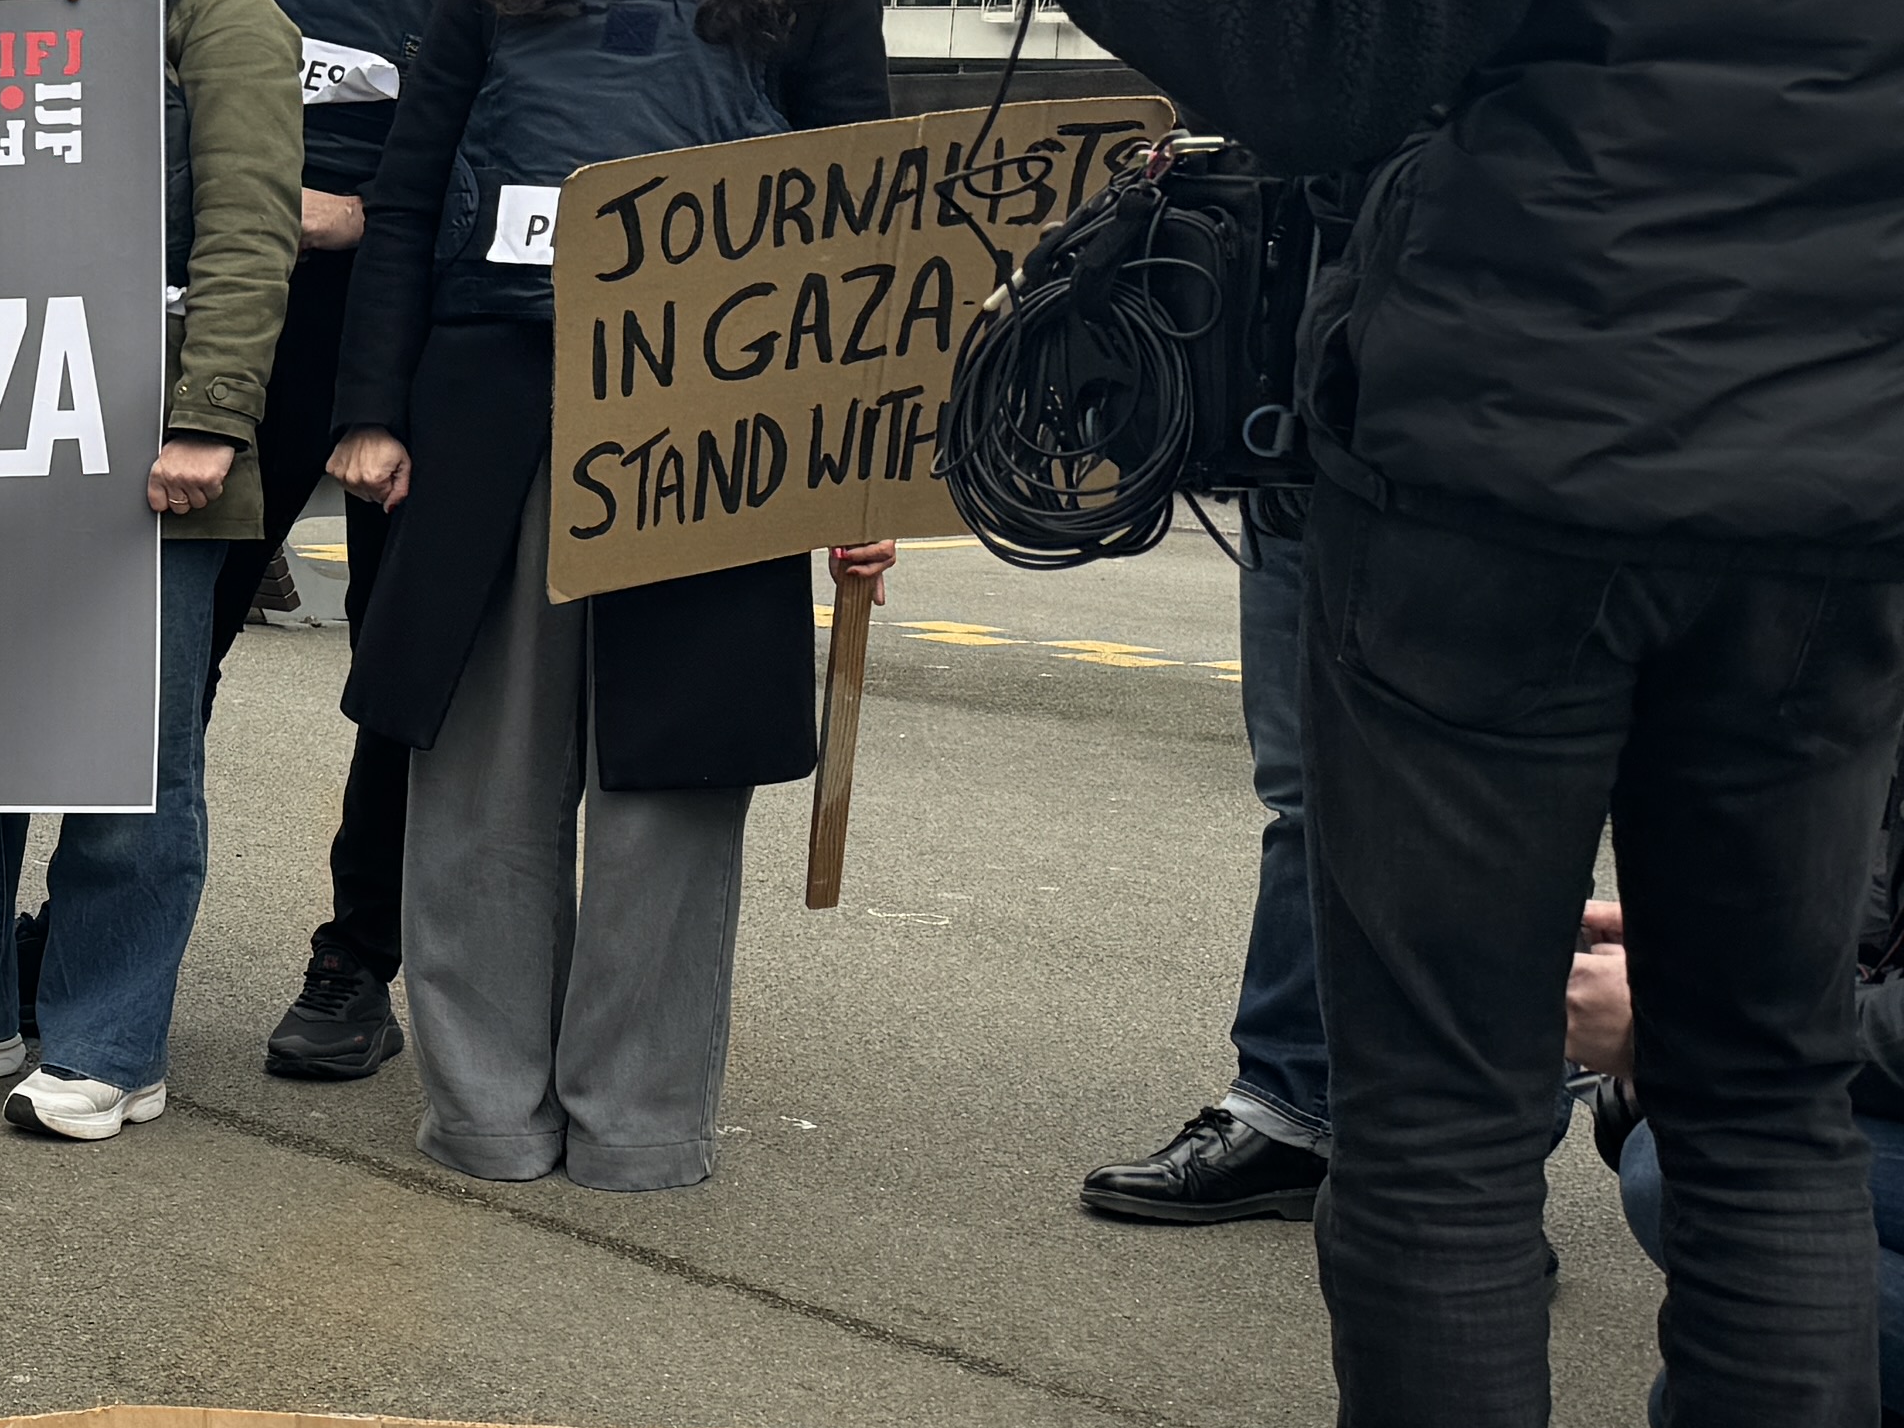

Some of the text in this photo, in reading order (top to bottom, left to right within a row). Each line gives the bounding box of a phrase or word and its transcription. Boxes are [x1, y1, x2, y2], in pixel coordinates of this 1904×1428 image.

[591, 299, 677, 400] IN
[569, 384, 950, 540] STAND WITH
